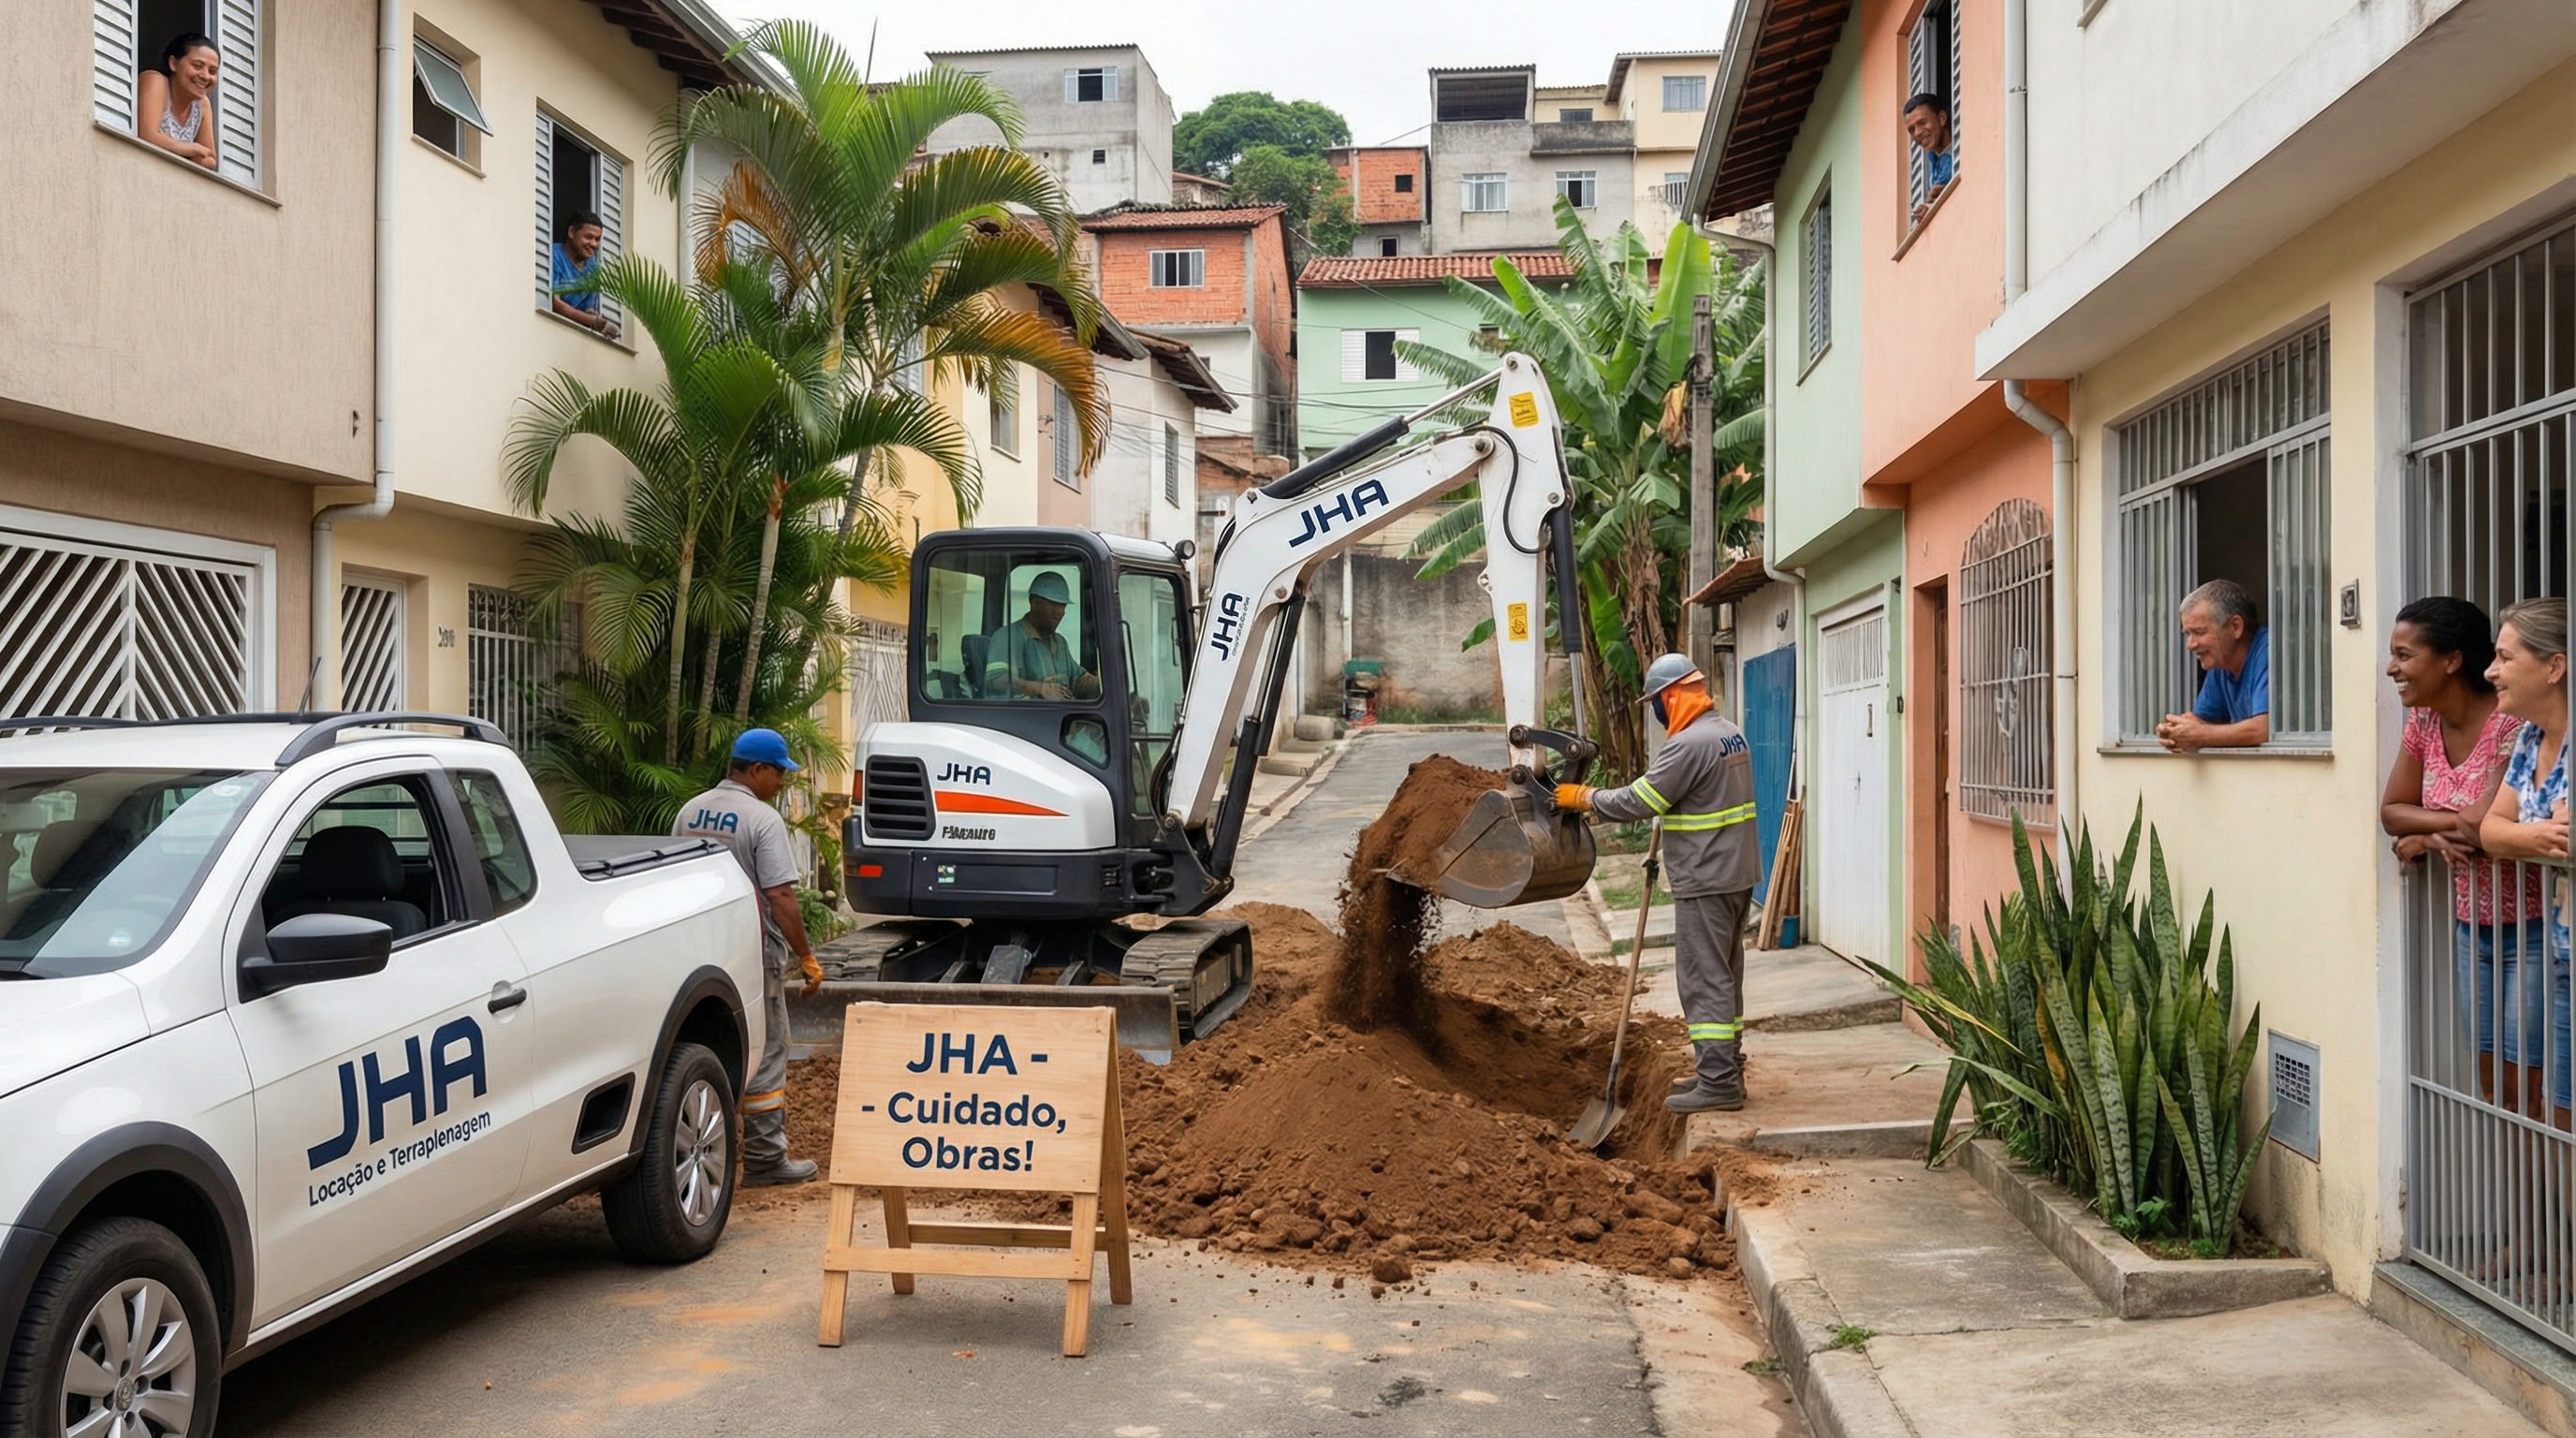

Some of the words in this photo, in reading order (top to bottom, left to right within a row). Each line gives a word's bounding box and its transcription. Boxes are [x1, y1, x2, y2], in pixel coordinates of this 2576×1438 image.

[1288, 478, 1390, 549] JHA
[1210, 592, 1243, 662] JHA
[937, 762, 991, 785] JHA
[687, 809, 739, 834] JHA
[906, 1033, 1018, 1076] JHA
[307, 1015, 487, 1171] JHA
[887, 1091, 1067, 1135] Cuidado,
[308, 1162, 373, 1208] Locação
[376, 1158, 387, 1175] e
[388, 1110, 491, 1169] Terraplenagem
[901, 1136, 1034, 1172] Obras!
